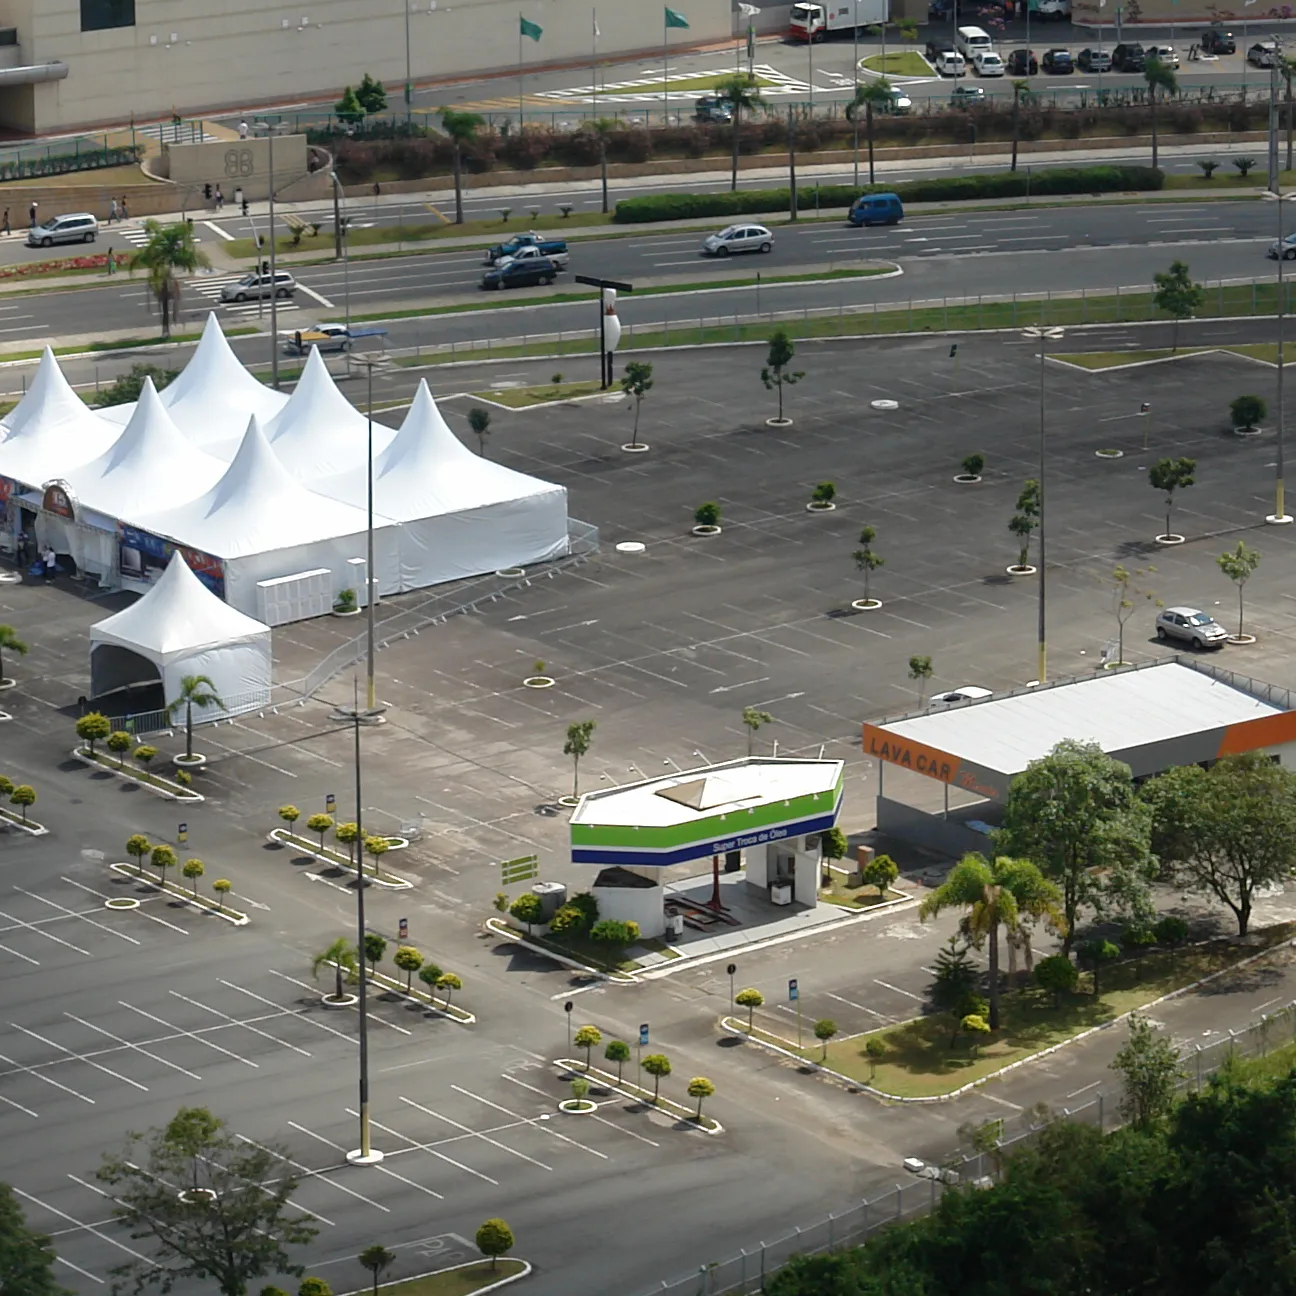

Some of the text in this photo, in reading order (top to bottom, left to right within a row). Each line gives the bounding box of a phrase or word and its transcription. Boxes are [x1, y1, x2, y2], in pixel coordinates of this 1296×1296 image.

[869, 737, 951, 781] LAVA CAR
[712, 827, 788, 853] Super Troca de Óleo
